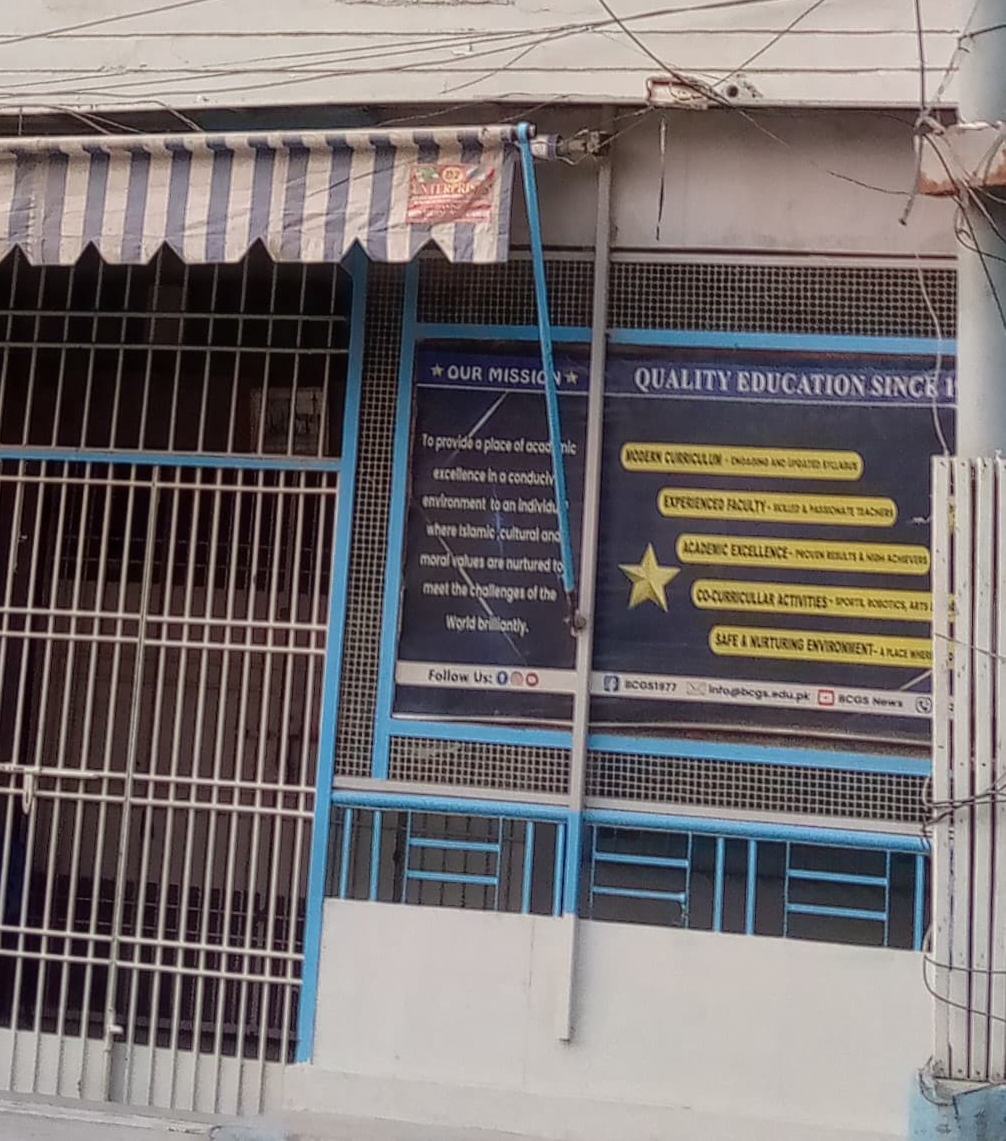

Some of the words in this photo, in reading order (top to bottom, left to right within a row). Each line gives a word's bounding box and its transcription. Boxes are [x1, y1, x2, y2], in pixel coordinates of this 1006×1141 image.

[447, 364, 483, 380] OUR
[634, 367, 732, 392] QUALITY
[737, 371, 865, 397] EDUCATION
[869, 375, 938, 398] SINCE
[422, 433, 435, 447] To
[435, 435, 473, 452] provide
[483, 437, 512, 454] place
[513, 438, 525, 452] of
[433, 467, 486, 482] excellence
[508, 470, 556, 486] conduciv
[422, 493, 486, 510] environment
[490, 498, 501, 511] to
[502, 500, 517, 512] an
[664, 495, 725, 511] EXPERIENCED
[426, 522, 457, 537] where
[683, 541, 728, 556] ACADEMIC
[420, 553, 450, 567] moral
[452, 555, 485, 569] values
[487, 558, 504, 570] are
[506, 559, 551, 572] nurtured
[553, 560, 564, 573] to
[423, 582, 450, 596] meet
[451, 582, 468, 597] the
[470, 584, 525, 603] challenges
[527, 585, 538, 600] of
[539, 587, 557, 602] the
[446, 614, 476, 629] World
[715, 633, 738, 647] SAFE
[749, 636, 804, 651] NURTURING
[428, 669, 470, 683] Follow
[874, 697, 903, 708] News
